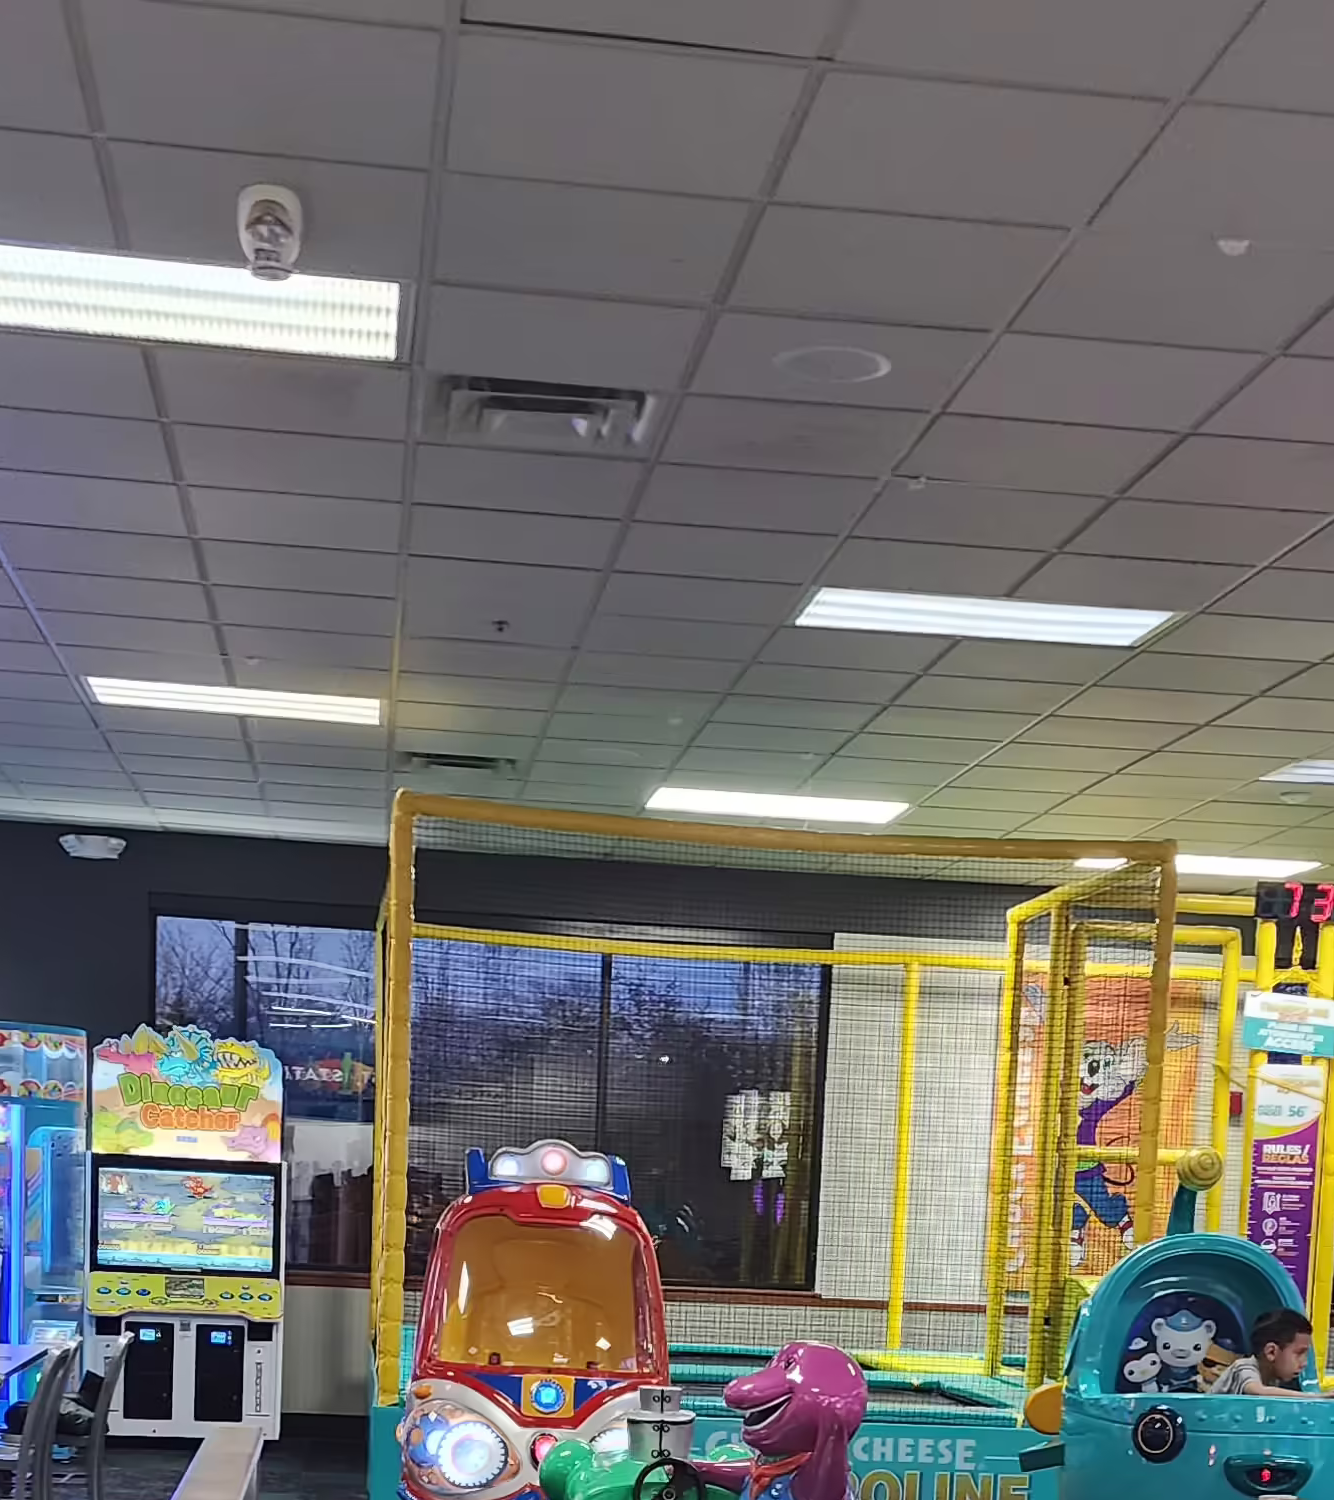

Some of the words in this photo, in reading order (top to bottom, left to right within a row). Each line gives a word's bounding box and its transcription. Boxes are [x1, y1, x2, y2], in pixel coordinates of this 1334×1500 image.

[140, 1102, 241, 1132] Catcher
[1261, 1153, 1310, 1165] REGLAS
[853, 1437, 977, 1470] CHEESE
